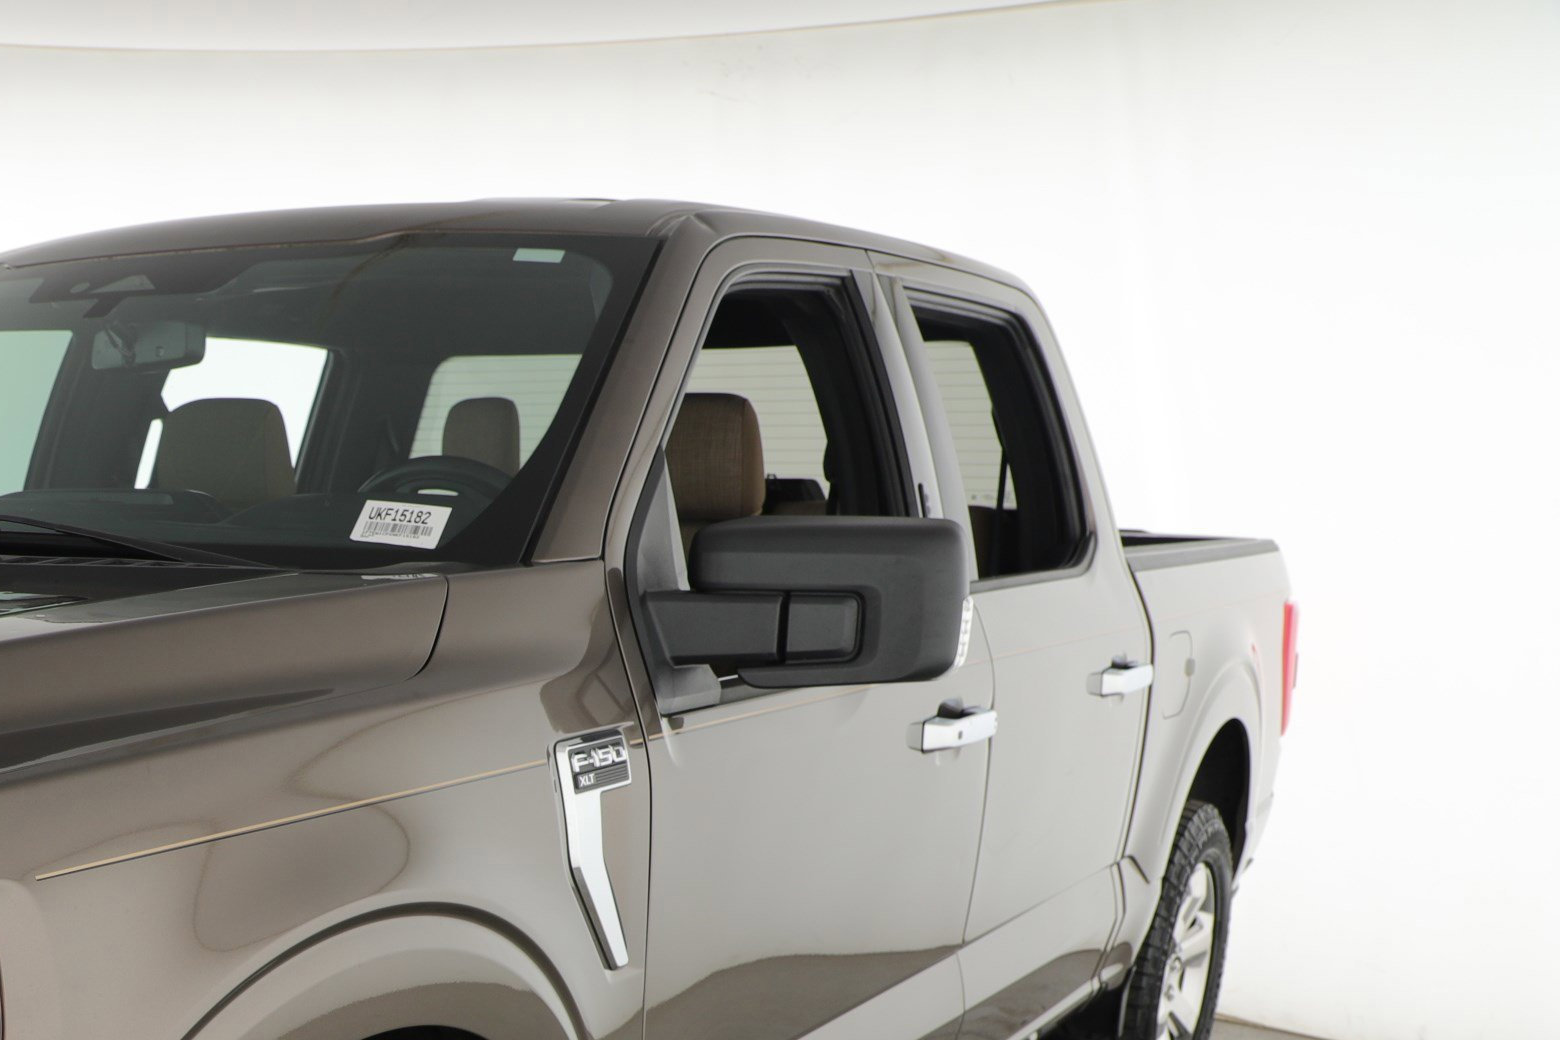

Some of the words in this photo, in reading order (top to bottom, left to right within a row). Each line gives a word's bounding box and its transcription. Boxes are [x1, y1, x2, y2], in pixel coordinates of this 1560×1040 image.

[368, 506, 432, 525] UKF15182
[571, 744, 627, 773] F-150
[578, 773, 596, 788] XLT
